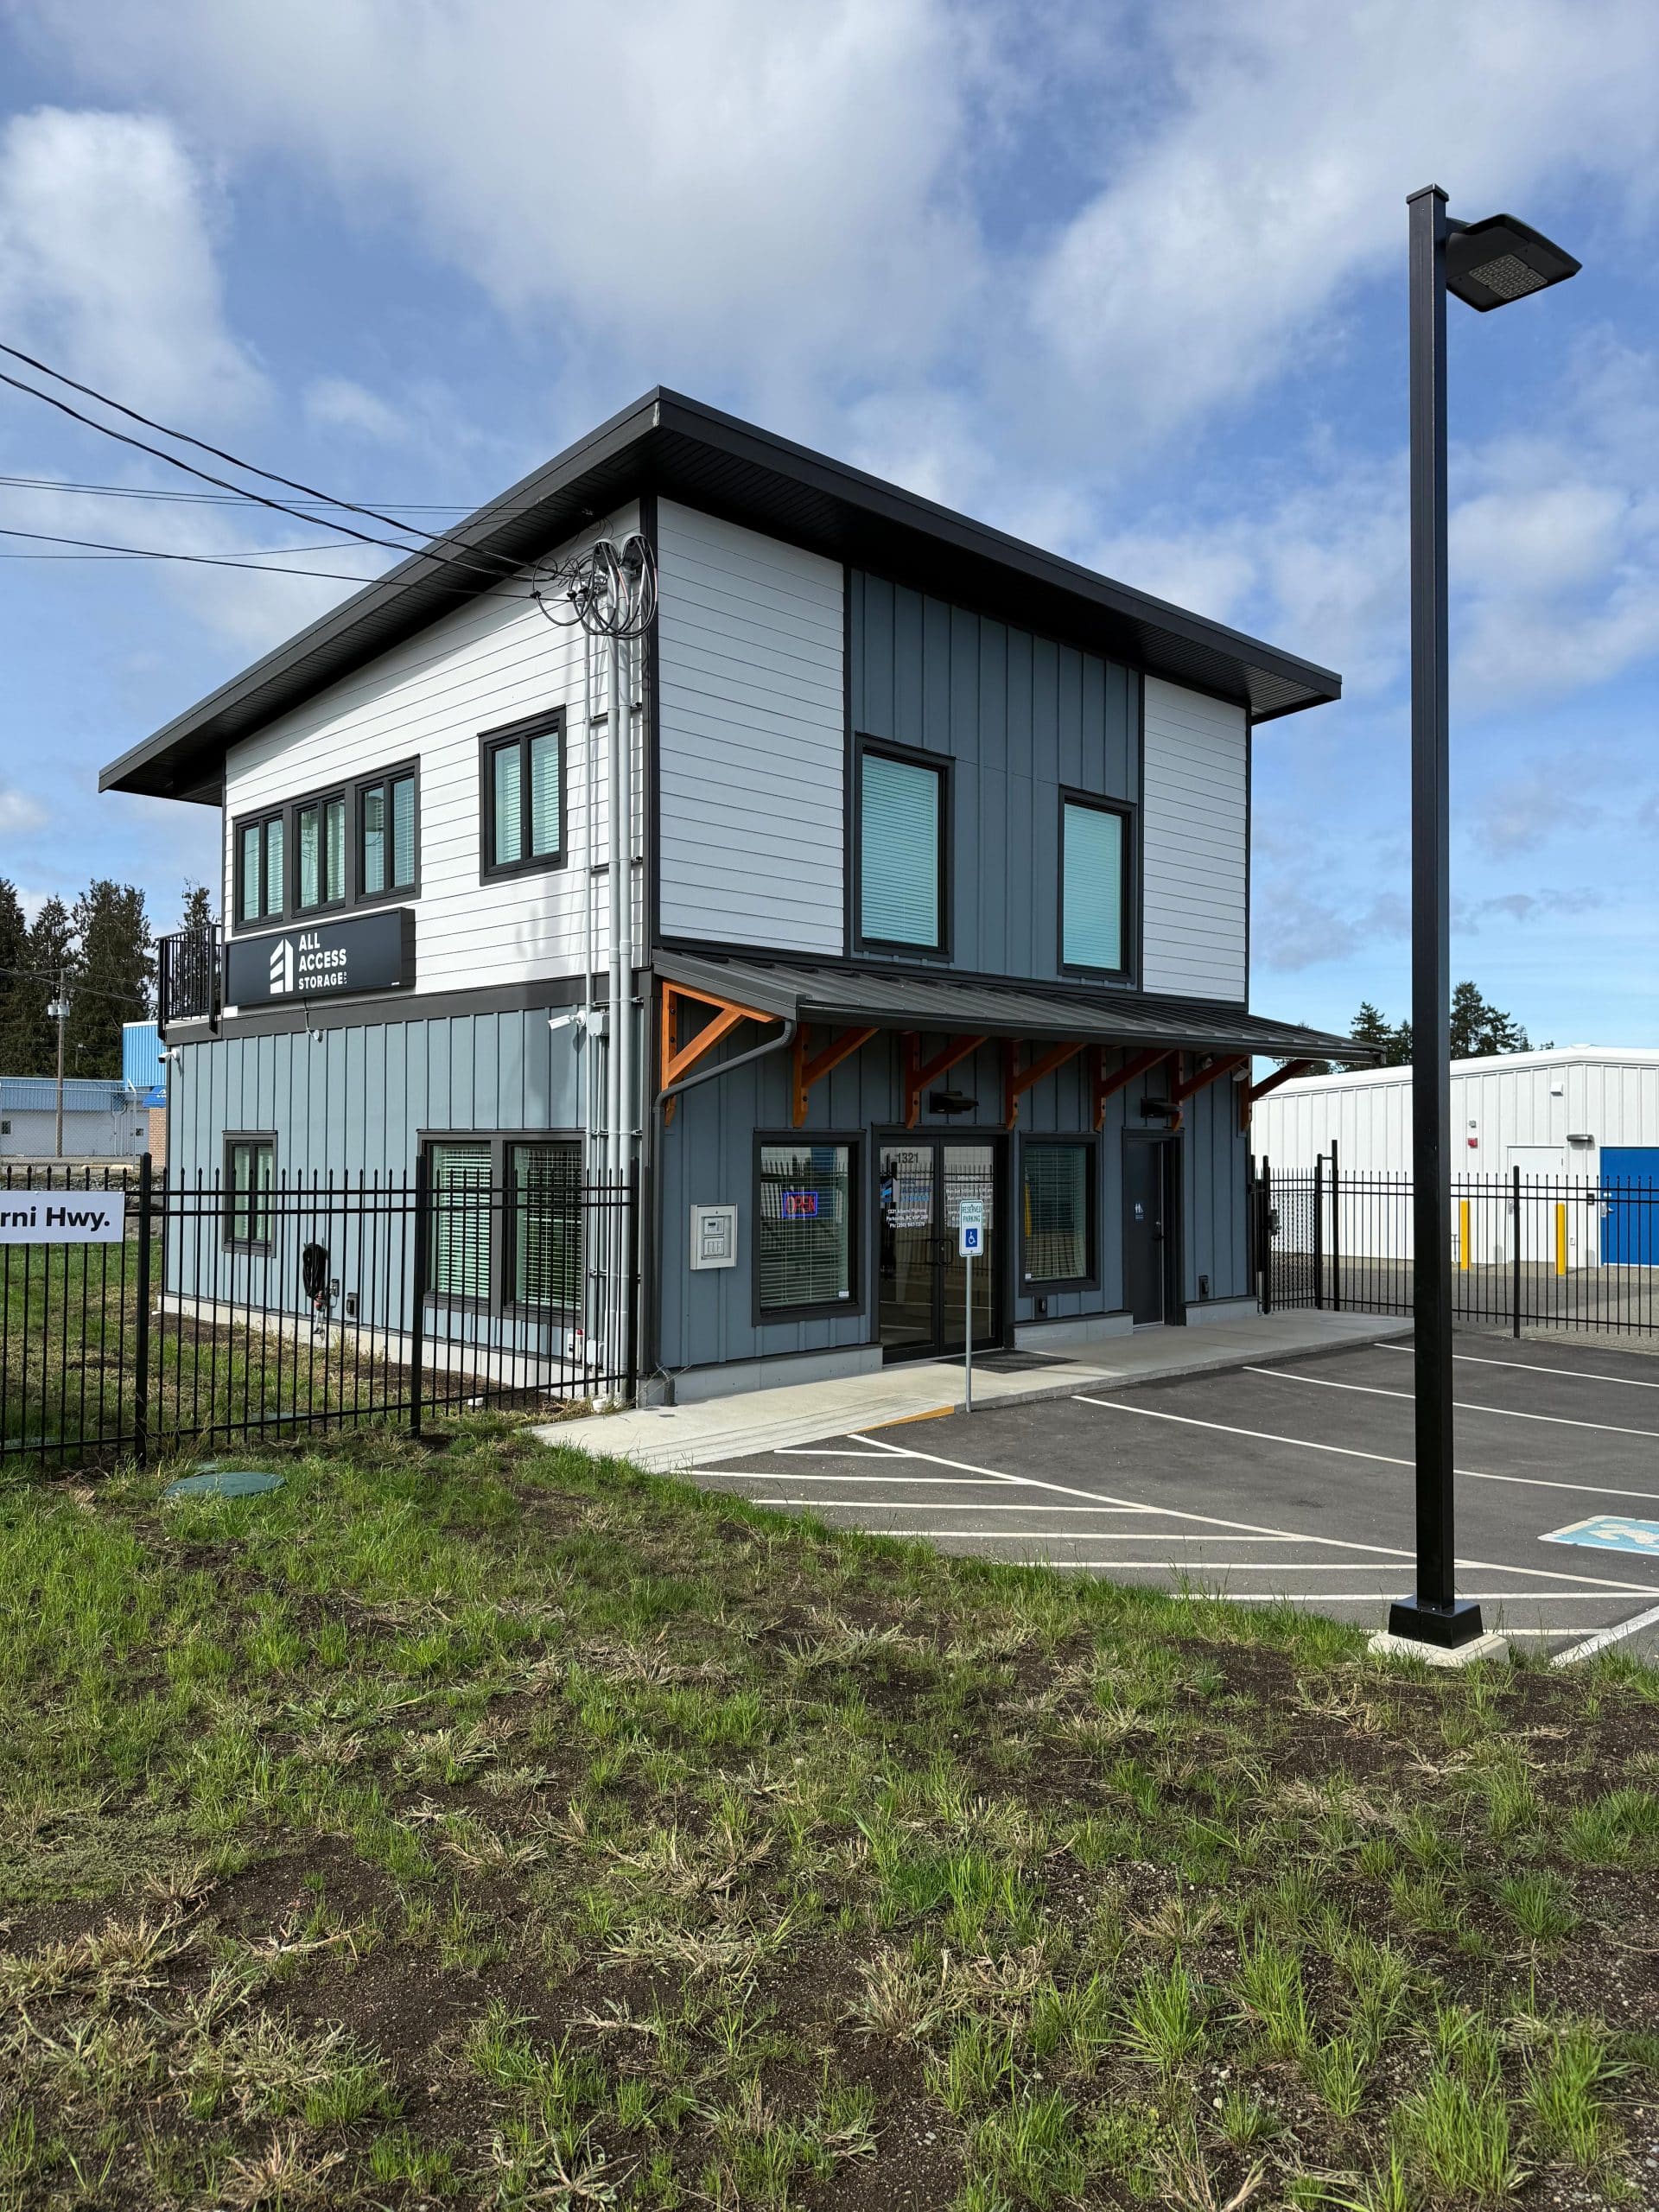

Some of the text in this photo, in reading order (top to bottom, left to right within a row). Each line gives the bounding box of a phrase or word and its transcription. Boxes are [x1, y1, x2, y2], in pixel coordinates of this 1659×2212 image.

[298, 932, 321, 951] ALL
[298, 949, 347, 972] ACCESS
[298, 971, 344, 990] STORAGE
[897, 1152, 918, 1164] 1321
[786, 1195, 816, 1214] OPEN
[961, 1205, 982, 1214] RESERVED
[46, 1207, 110, 1232] Hwy.
